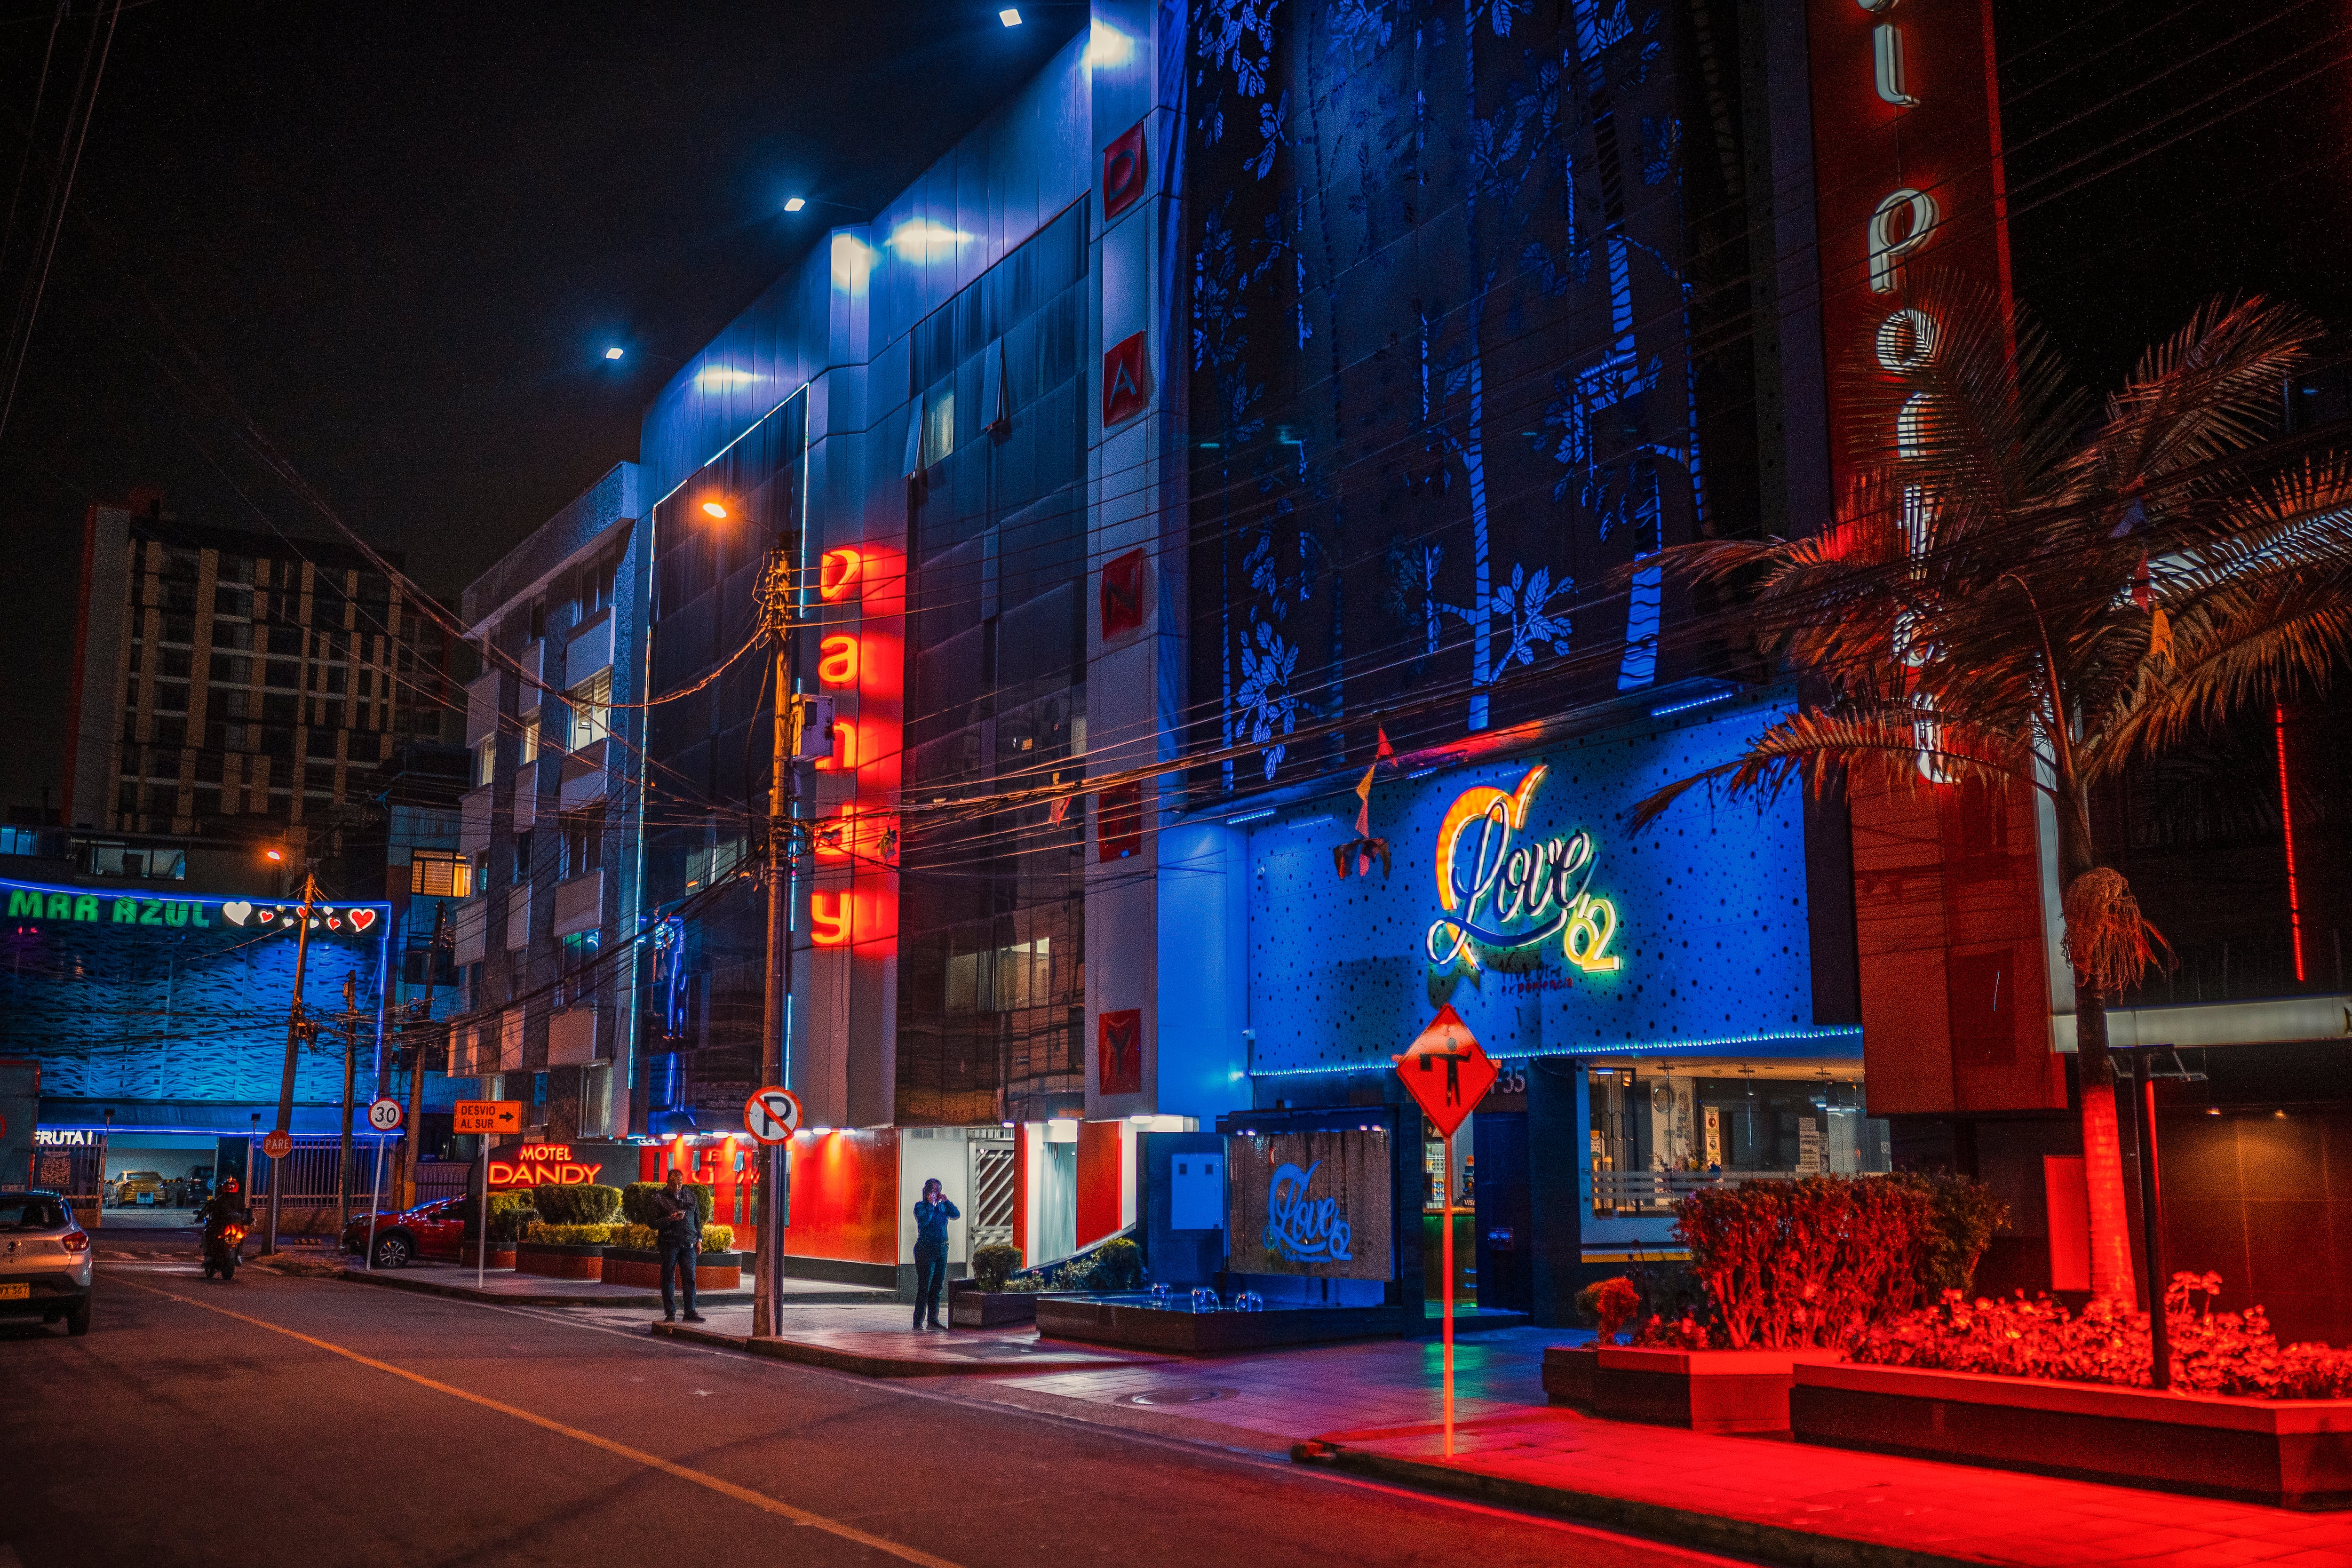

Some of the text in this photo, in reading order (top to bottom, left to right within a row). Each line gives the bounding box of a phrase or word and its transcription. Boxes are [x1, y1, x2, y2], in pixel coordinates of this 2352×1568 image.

[1856, 0, 1920, 106] l
[1427, 794, 1600, 965] Love
[8, 889, 209, 928] MAR AZUL
[1564, 894, 1620, 973] 62
[1491, 1065, 1526, 1094] -35
[374, 1106, 397, 1123] 30
[461, 1106, 495, 1115] DESVIO
[461, 1119, 494, 1129] AL SUR
[266, 1139, 289, 1149] PARE
[520, 1146, 572, 1161] MOTEL
[489, 1163, 602, 1185] DANDY
